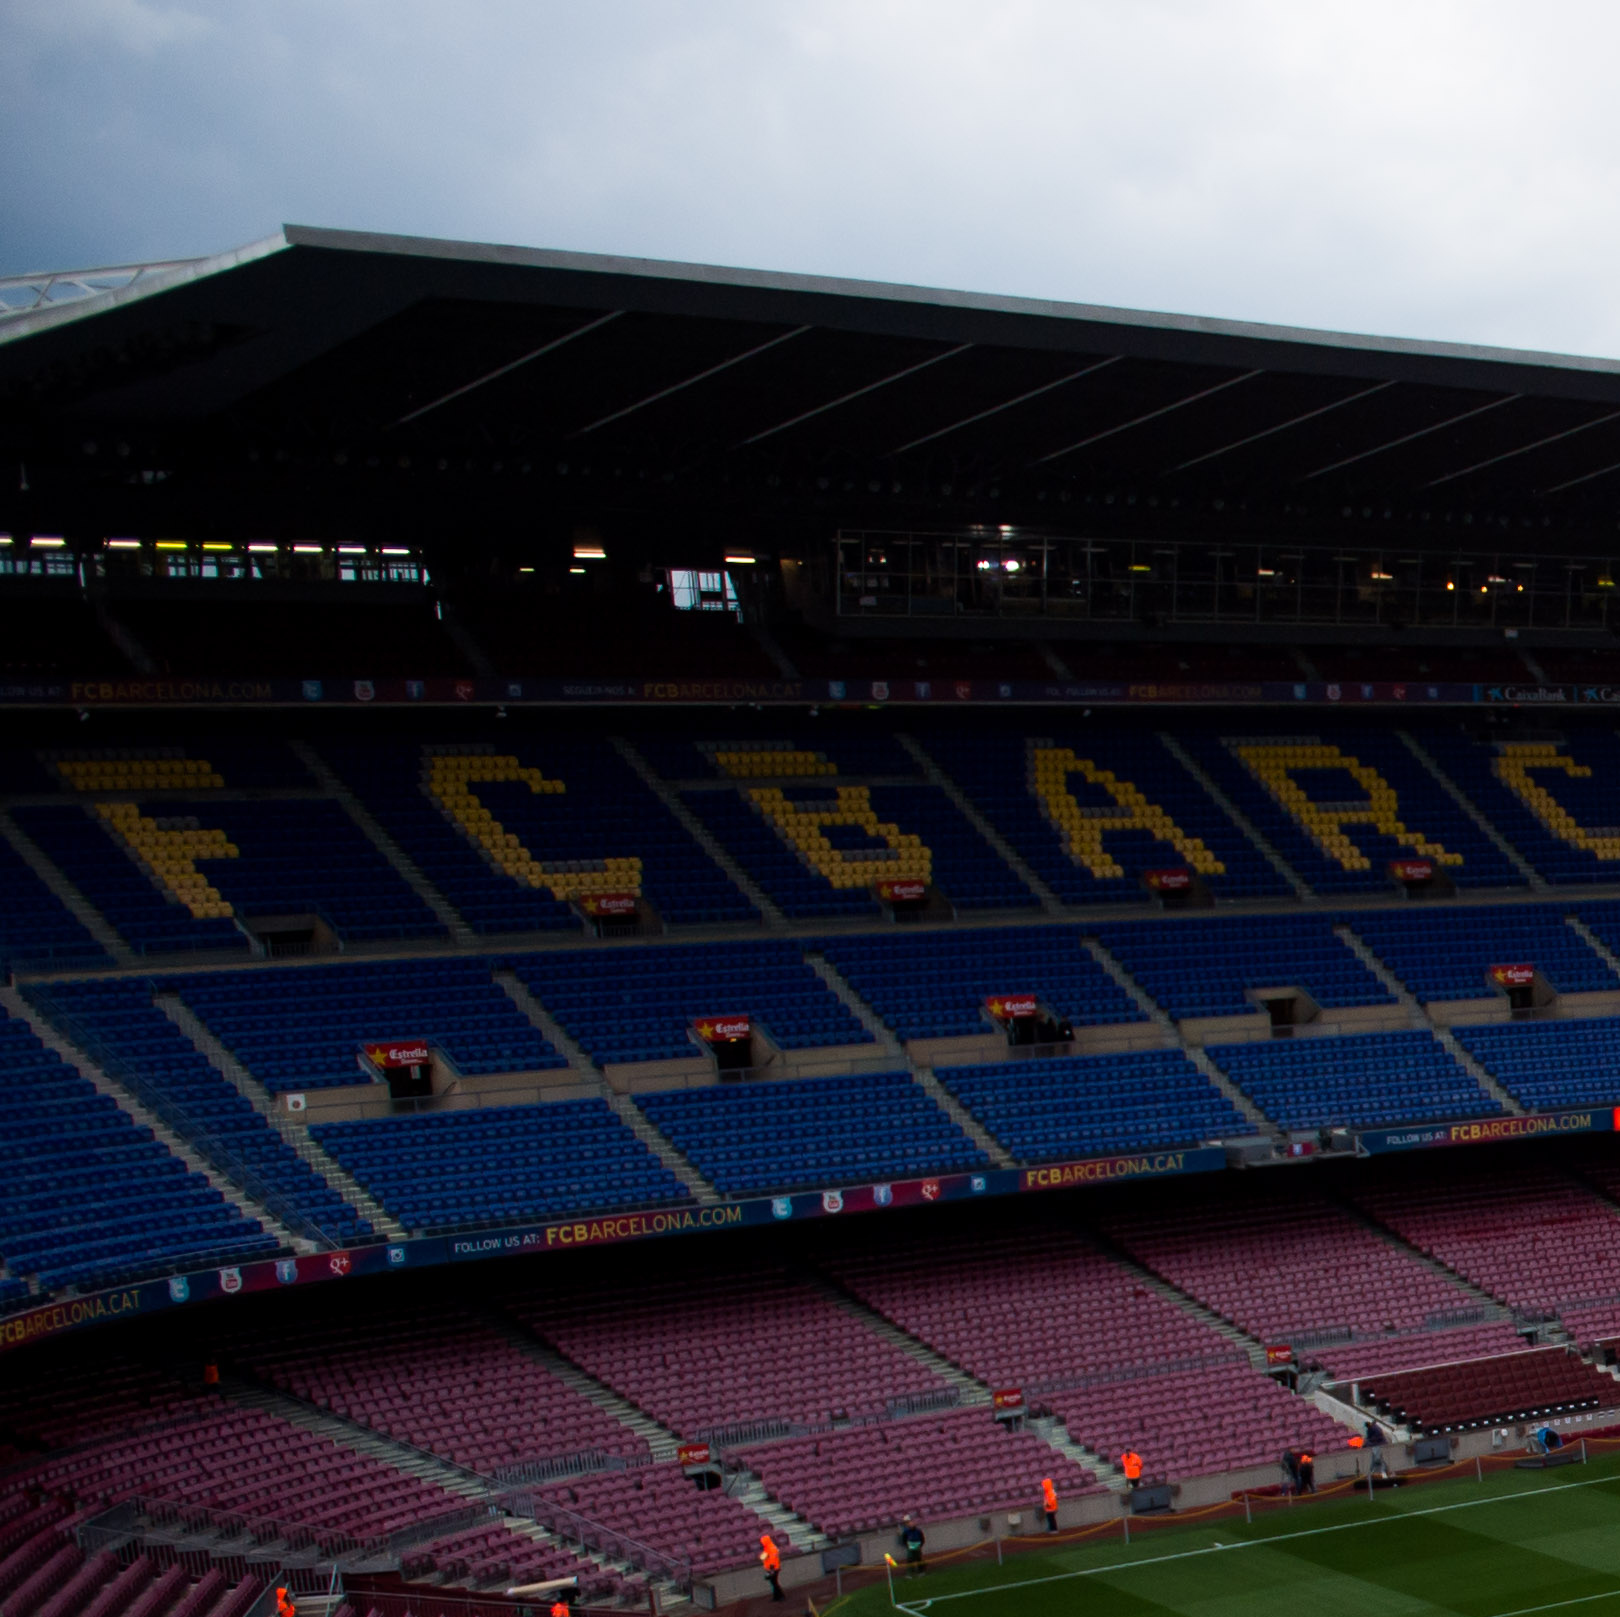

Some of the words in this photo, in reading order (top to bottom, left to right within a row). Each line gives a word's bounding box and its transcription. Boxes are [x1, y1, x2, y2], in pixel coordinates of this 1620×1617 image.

[714, 1021, 750, 1034] Estrella
[389, 1045, 428, 1060] Estrella
[1450, 1113, 1592, 1142] FCBARCELONA.COM
[1026, 1153, 1185, 1187] FCBARCELONA.CAT
[454, 1238, 502, 1254] FOLLOW
[504, 1236, 520, 1248] US
[545, 1206, 743, 1246] FCBARCELONA.COM
